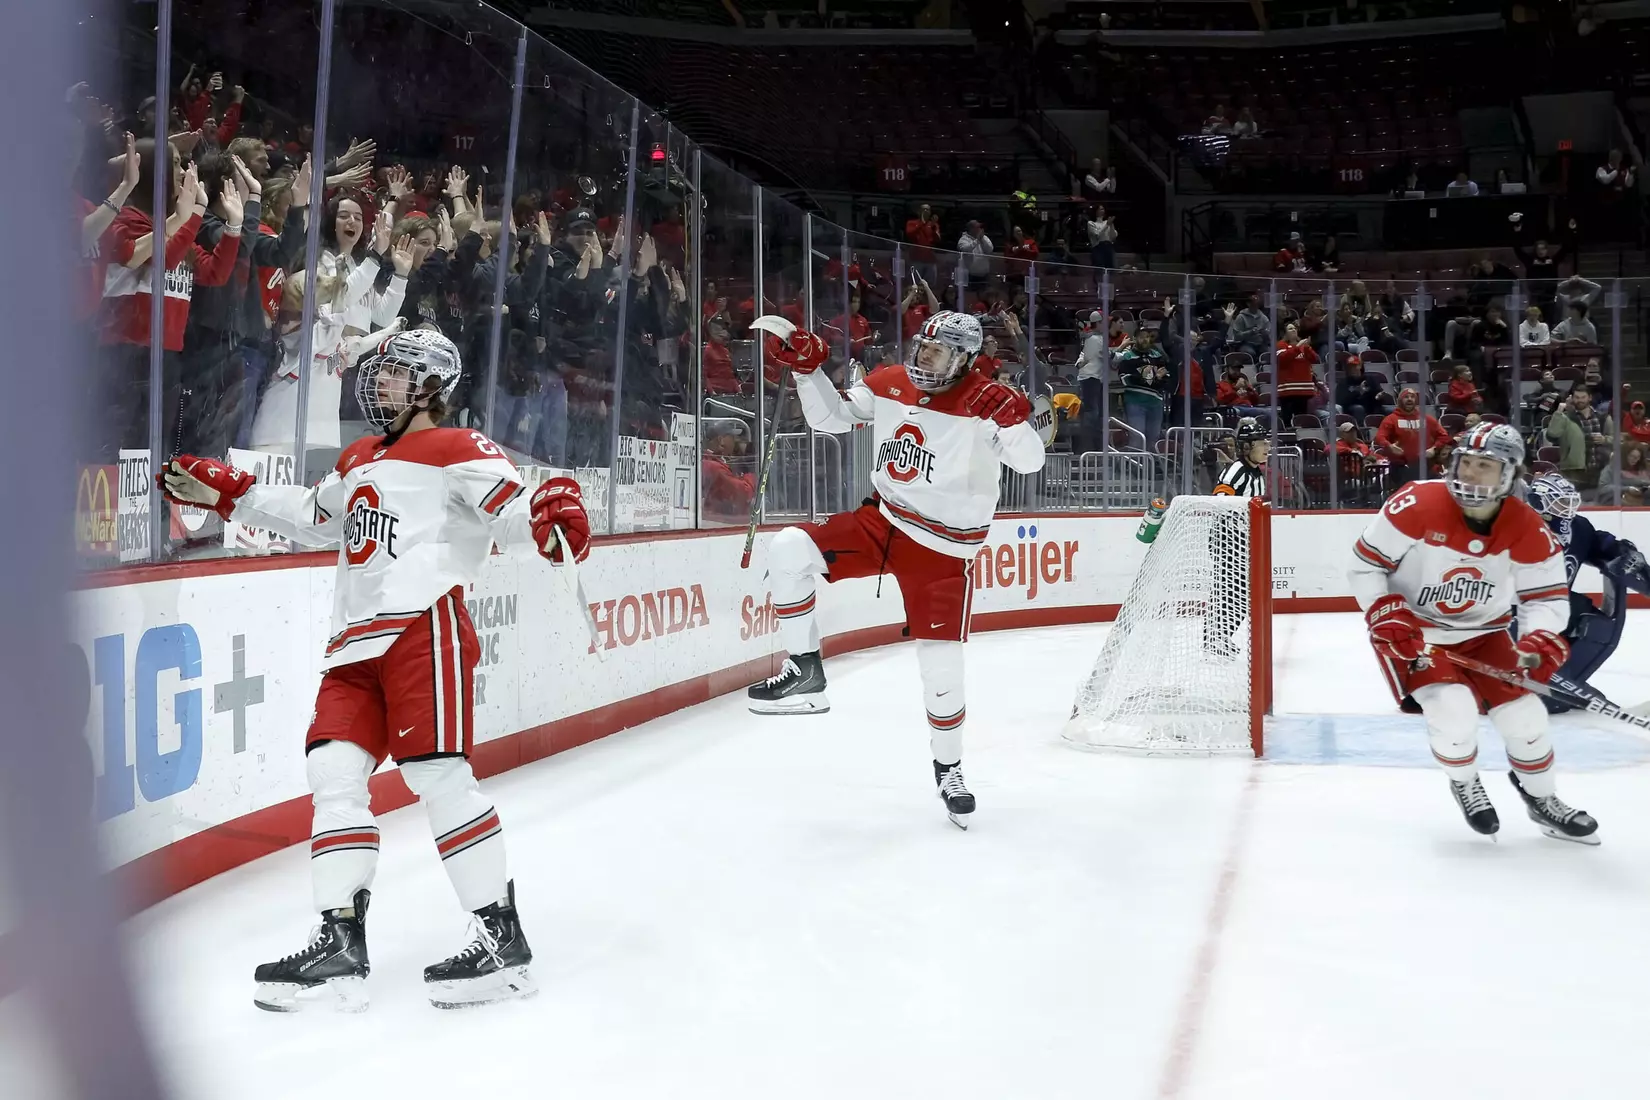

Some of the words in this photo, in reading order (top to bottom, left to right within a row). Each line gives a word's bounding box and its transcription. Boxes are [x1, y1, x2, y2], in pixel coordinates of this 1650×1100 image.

[452, 134, 475, 151] 117
[882, 167, 905, 181] 118
[1339, 167, 1364, 182] 118
[672, 413, 678, 441] 2
[470, 432, 508, 459] 2
[619, 436, 633, 457] BIG
[638, 442, 647, 456] WE
[657, 443, 669, 460] OUR
[636, 460, 667, 485] SENIORS
[875, 440, 902, 473] OHIO
[899, 438, 936, 484] STATE
[119, 457, 149, 498] THIES
[1388, 485, 1417, 515] 13
[353, 504, 399, 560] STATE
[1417, 581, 1454, 607] OHIO
[464, 593, 518, 631] RICAN
[588, 583, 710, 655] HONDA
